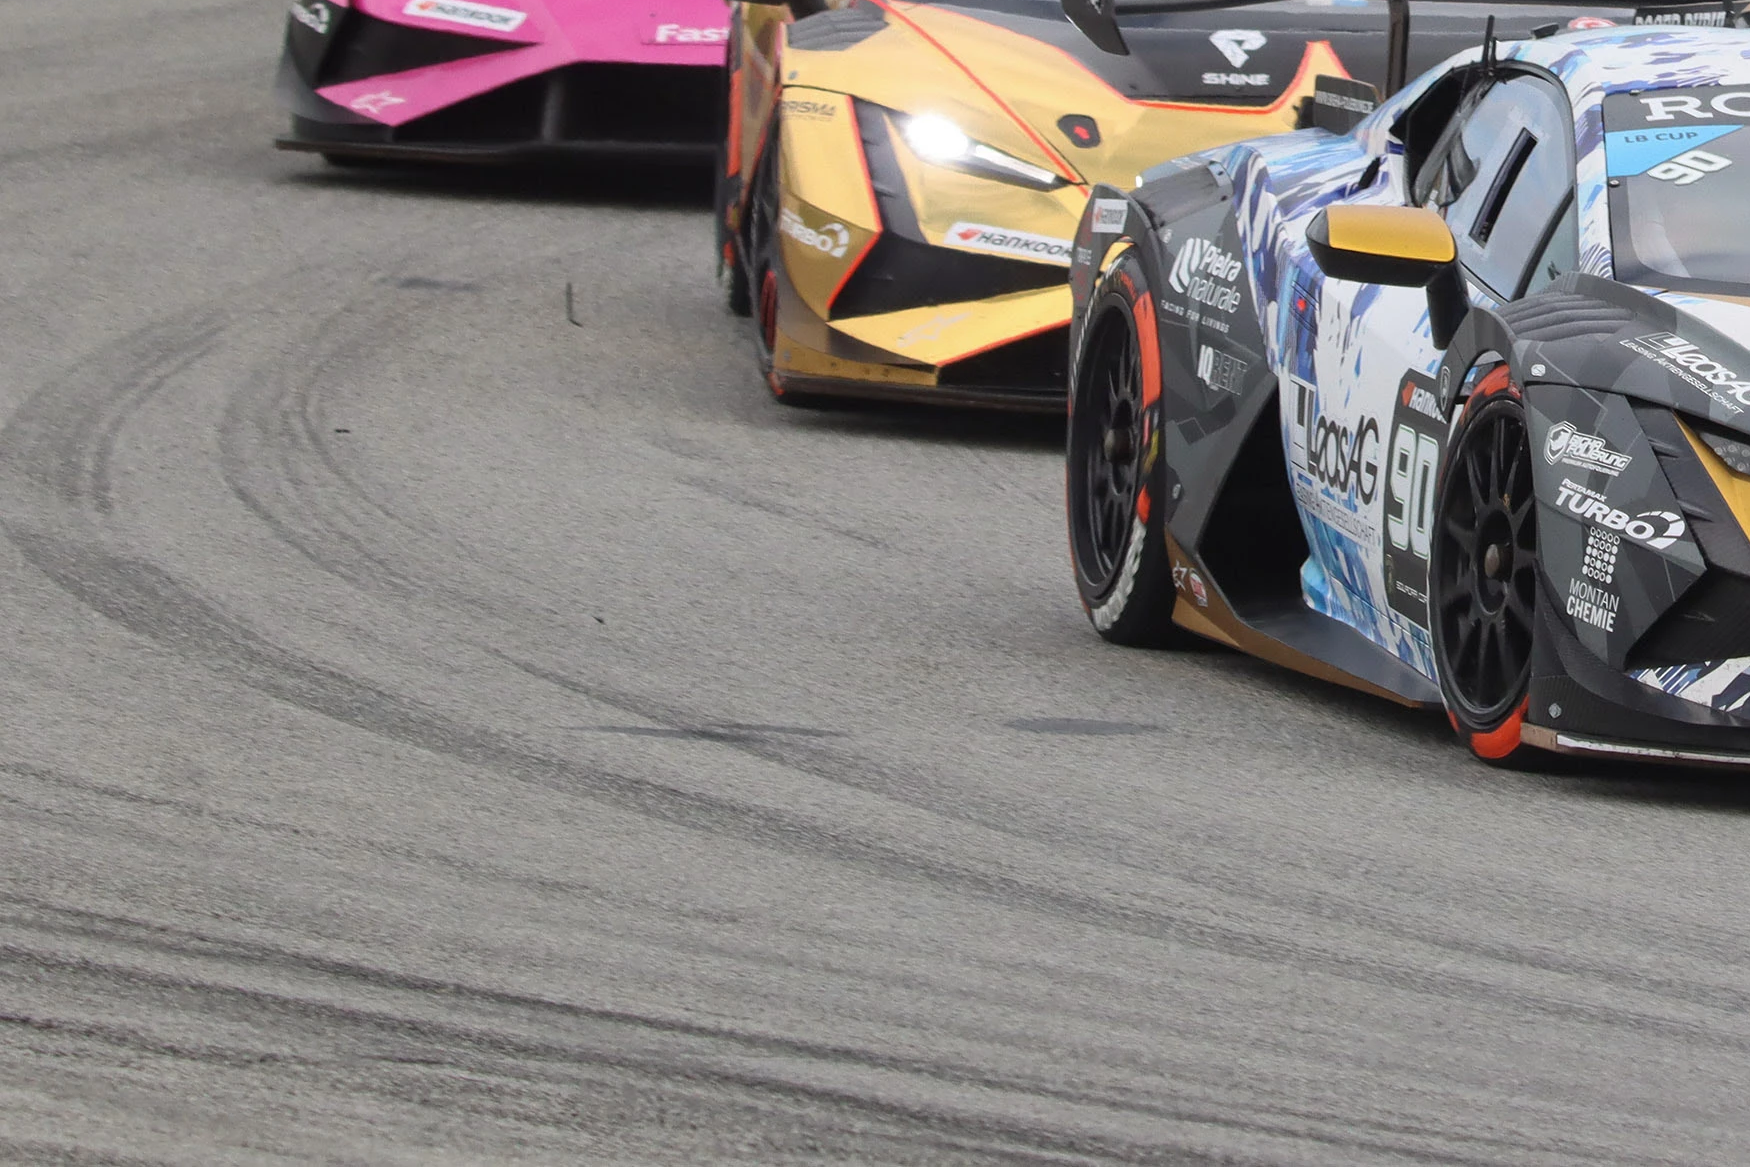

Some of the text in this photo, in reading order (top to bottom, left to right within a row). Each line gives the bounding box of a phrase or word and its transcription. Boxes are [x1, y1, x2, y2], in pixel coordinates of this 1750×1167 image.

[1202, 72, 1271, 86] SHINE
[1624, 132, 1699, 143] LB CUP
[1646, 149, 1733, 186] 90
[1187, 276, 1242, 313] naturale
[1387, 423, 1439, 560] 90
[1561, 478, 1608, 502] PERTAMAX
[1569, 578, 1621, 612] MONTAN
[1566, 595, 1618, 633] CHEMIE
